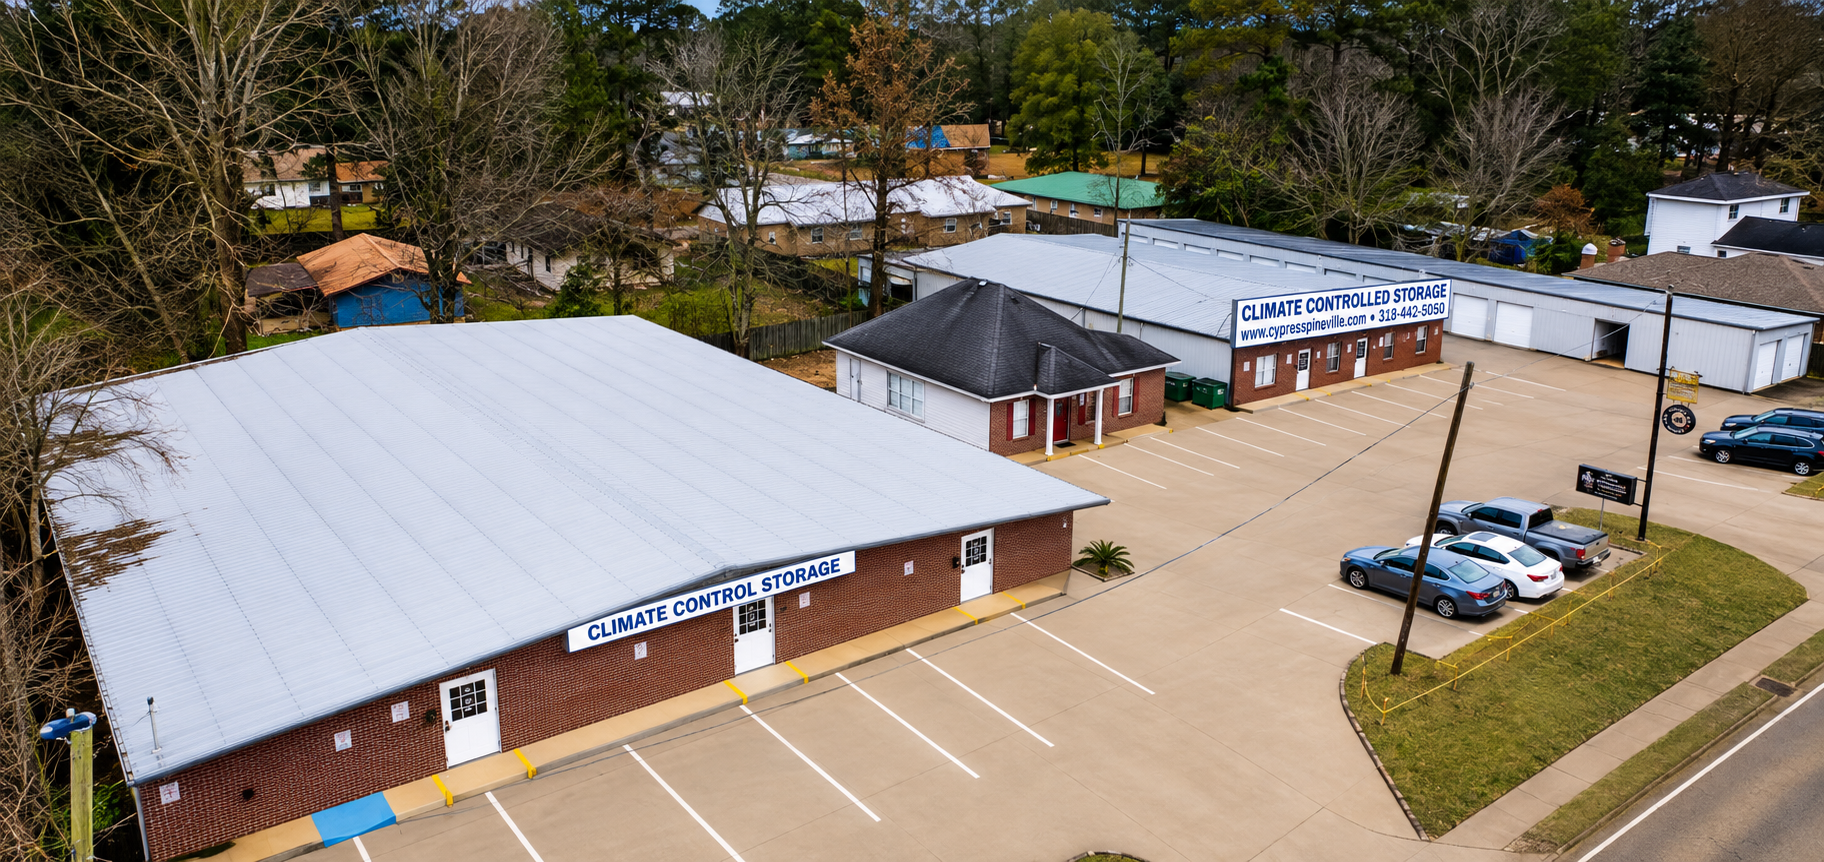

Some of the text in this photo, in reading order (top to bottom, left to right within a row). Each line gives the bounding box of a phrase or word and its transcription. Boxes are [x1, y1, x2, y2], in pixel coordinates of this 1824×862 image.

[1241, 302, 1445, 341] www.cypresspineville.com 318-442-5050
[1242, 283, 1447, 322] CLIMATE CONTROLLED STORAGE
[587, 605, 668, 641] CLIMATE
[673, 581, 757, 616] CONTROL
[761, 557, 841, 593] STORAGE
